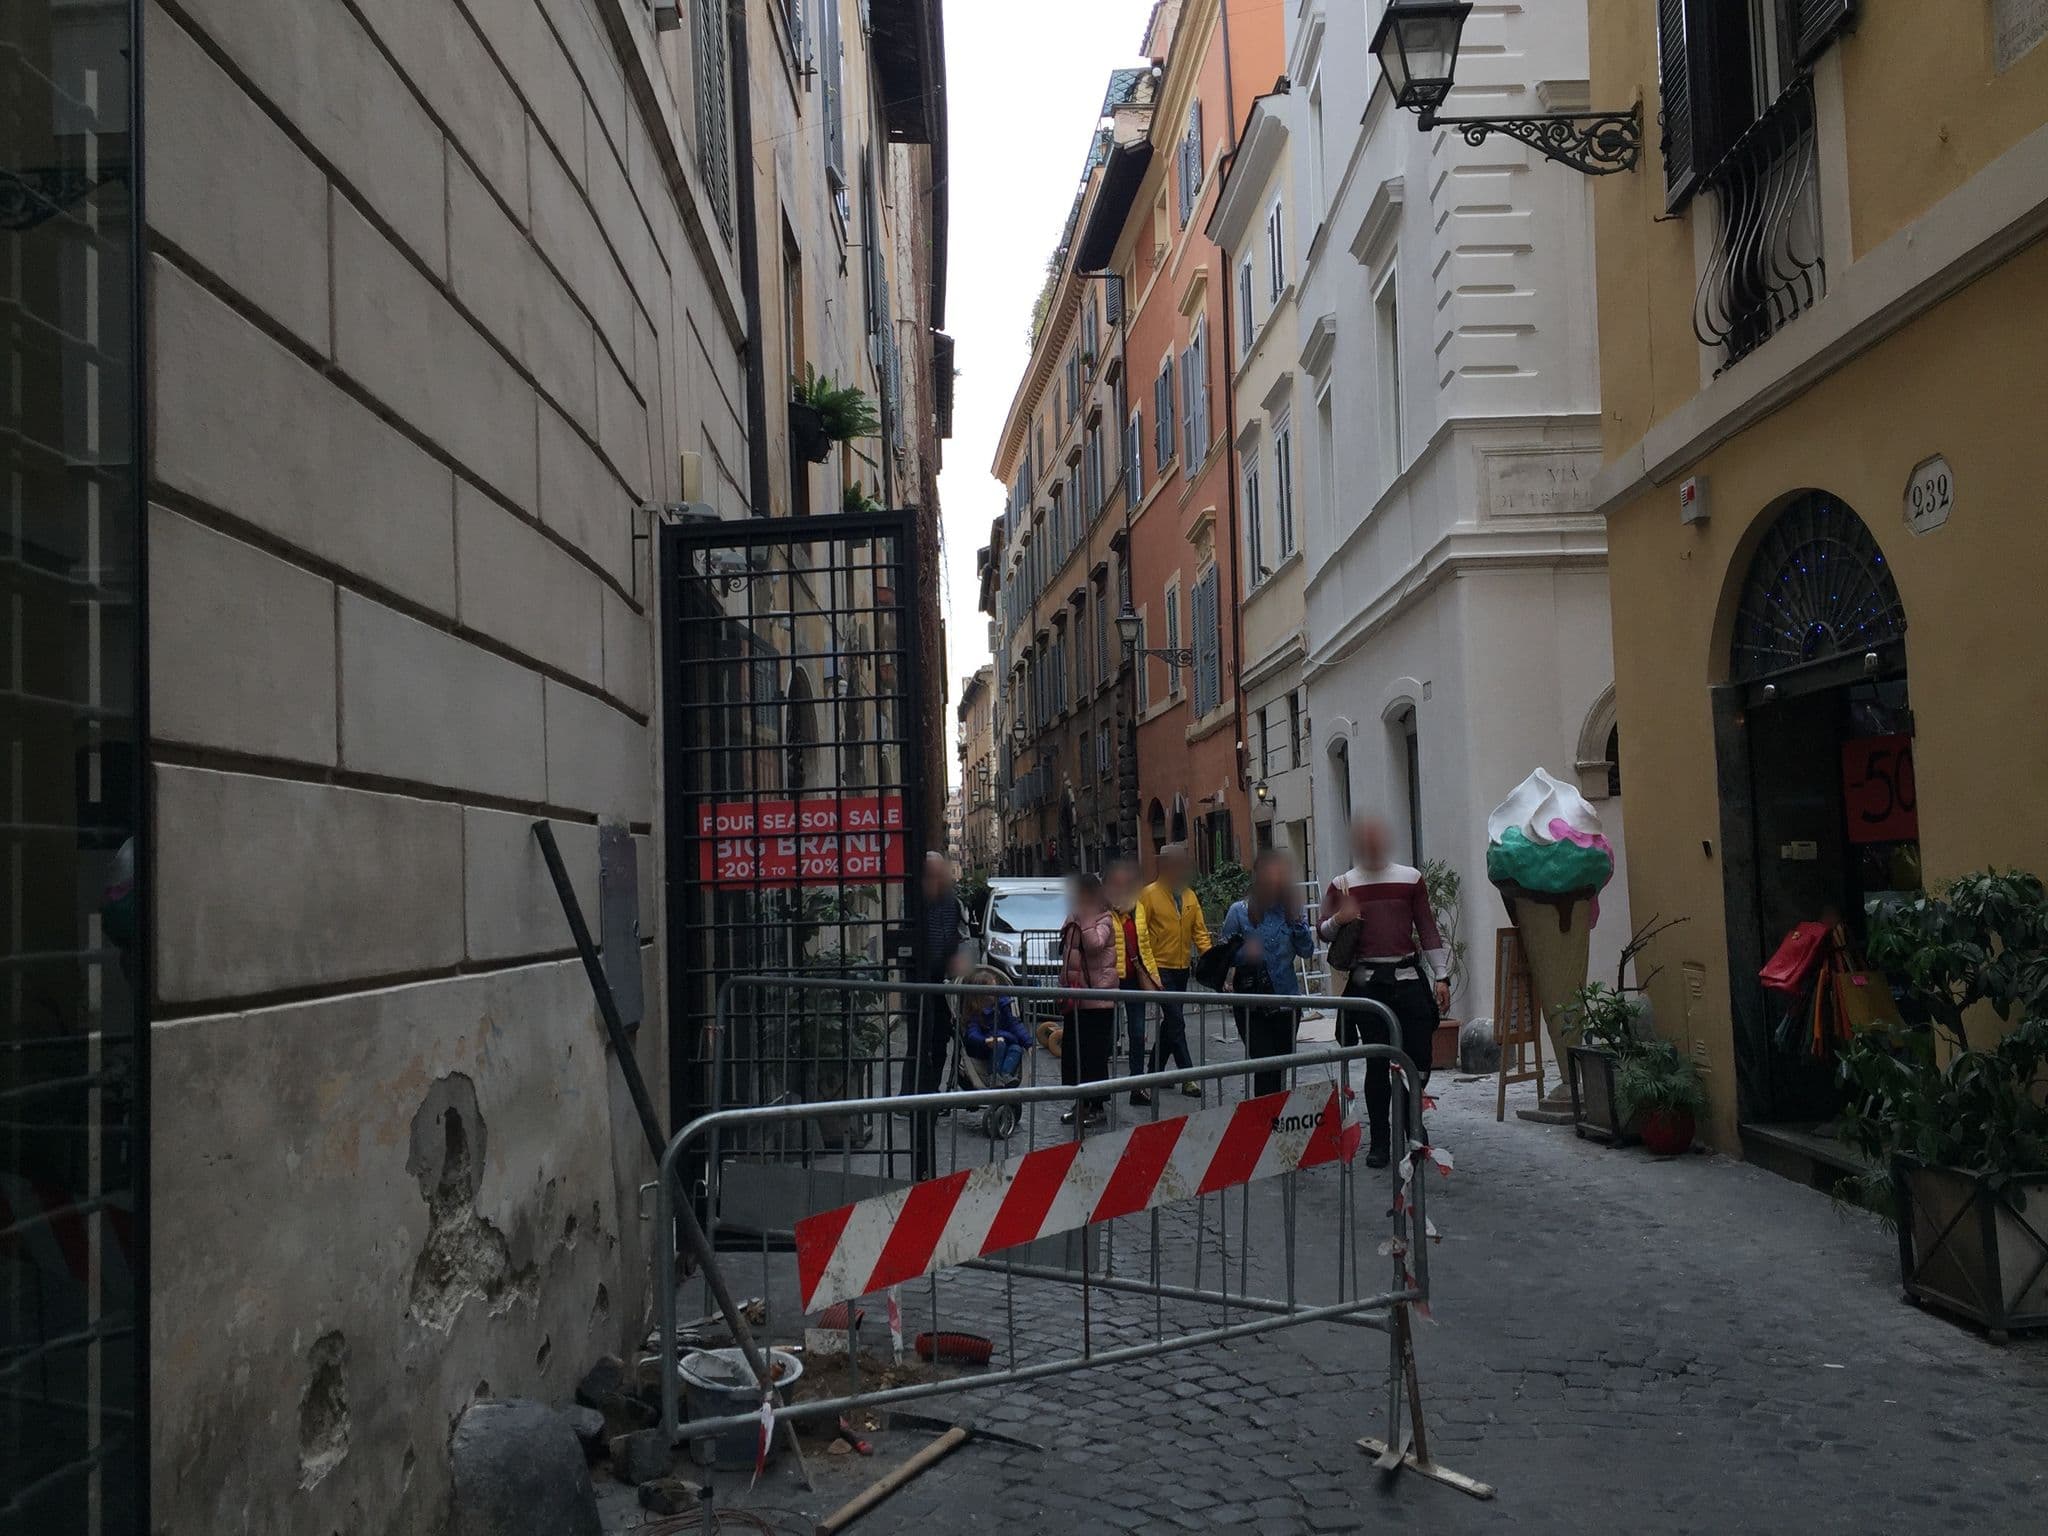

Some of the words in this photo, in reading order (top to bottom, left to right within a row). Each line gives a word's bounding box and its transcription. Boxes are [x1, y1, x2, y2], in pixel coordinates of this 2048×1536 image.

[1912, 473, 1949, 518] 232
[703, 815, 755, 832] FOUR
[763, 812, 839, 829] SEASON
[849, 808, 901, 826] SALE
[716, 837, 766, 858] BIG
[777, 832, 891, 856] BRAND
[717, 860, 766, 878] -20%
[771, 866, 786, 876] TO
